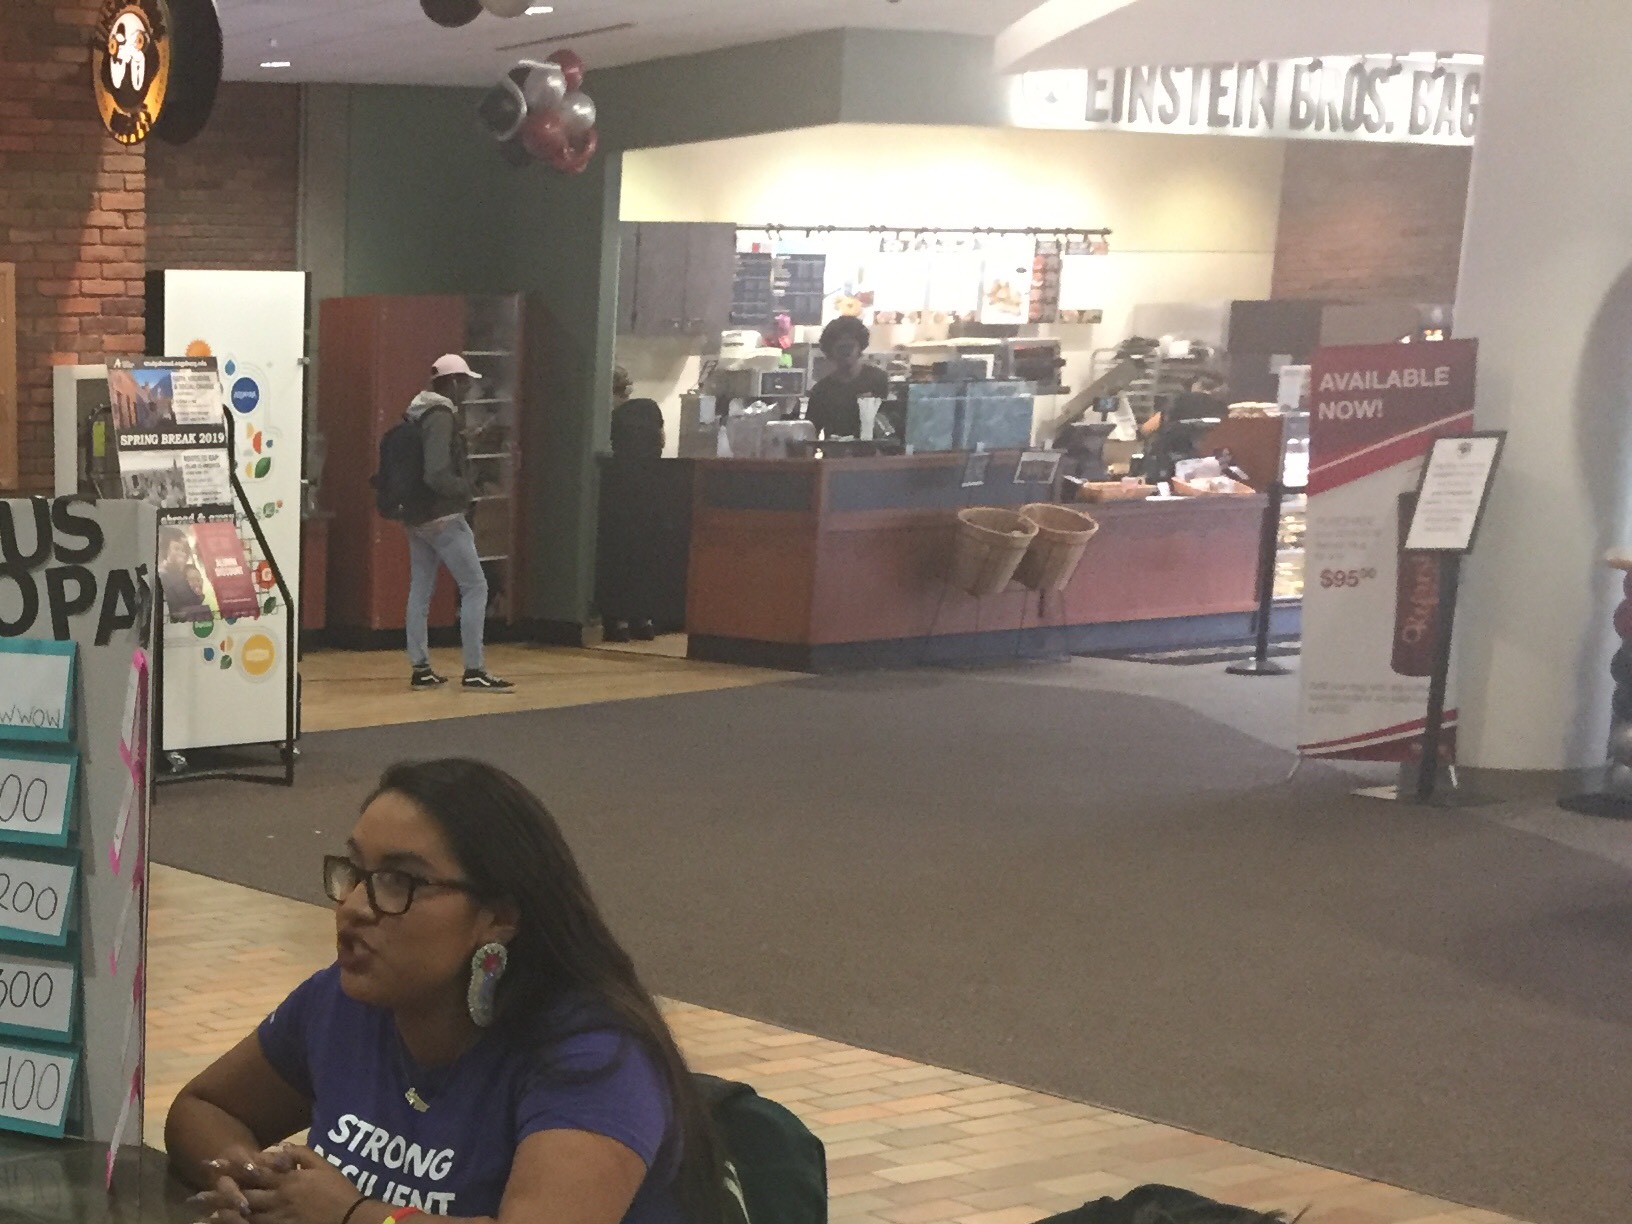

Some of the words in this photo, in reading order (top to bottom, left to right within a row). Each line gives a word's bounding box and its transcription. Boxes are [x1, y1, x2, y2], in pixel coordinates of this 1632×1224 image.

[1085, 62, 1278, 130] EINSTEIN
[1318, 366, 1450, 392] AVAILABLE
[1318, 399, 1384, 421] NOW!
[120, 433, 159, 446] SPRING
[161, 432, 197, 445] BREAK
[199, 432, 225, 444] 2019
[327, 1113, 455, 1181] STRONG
